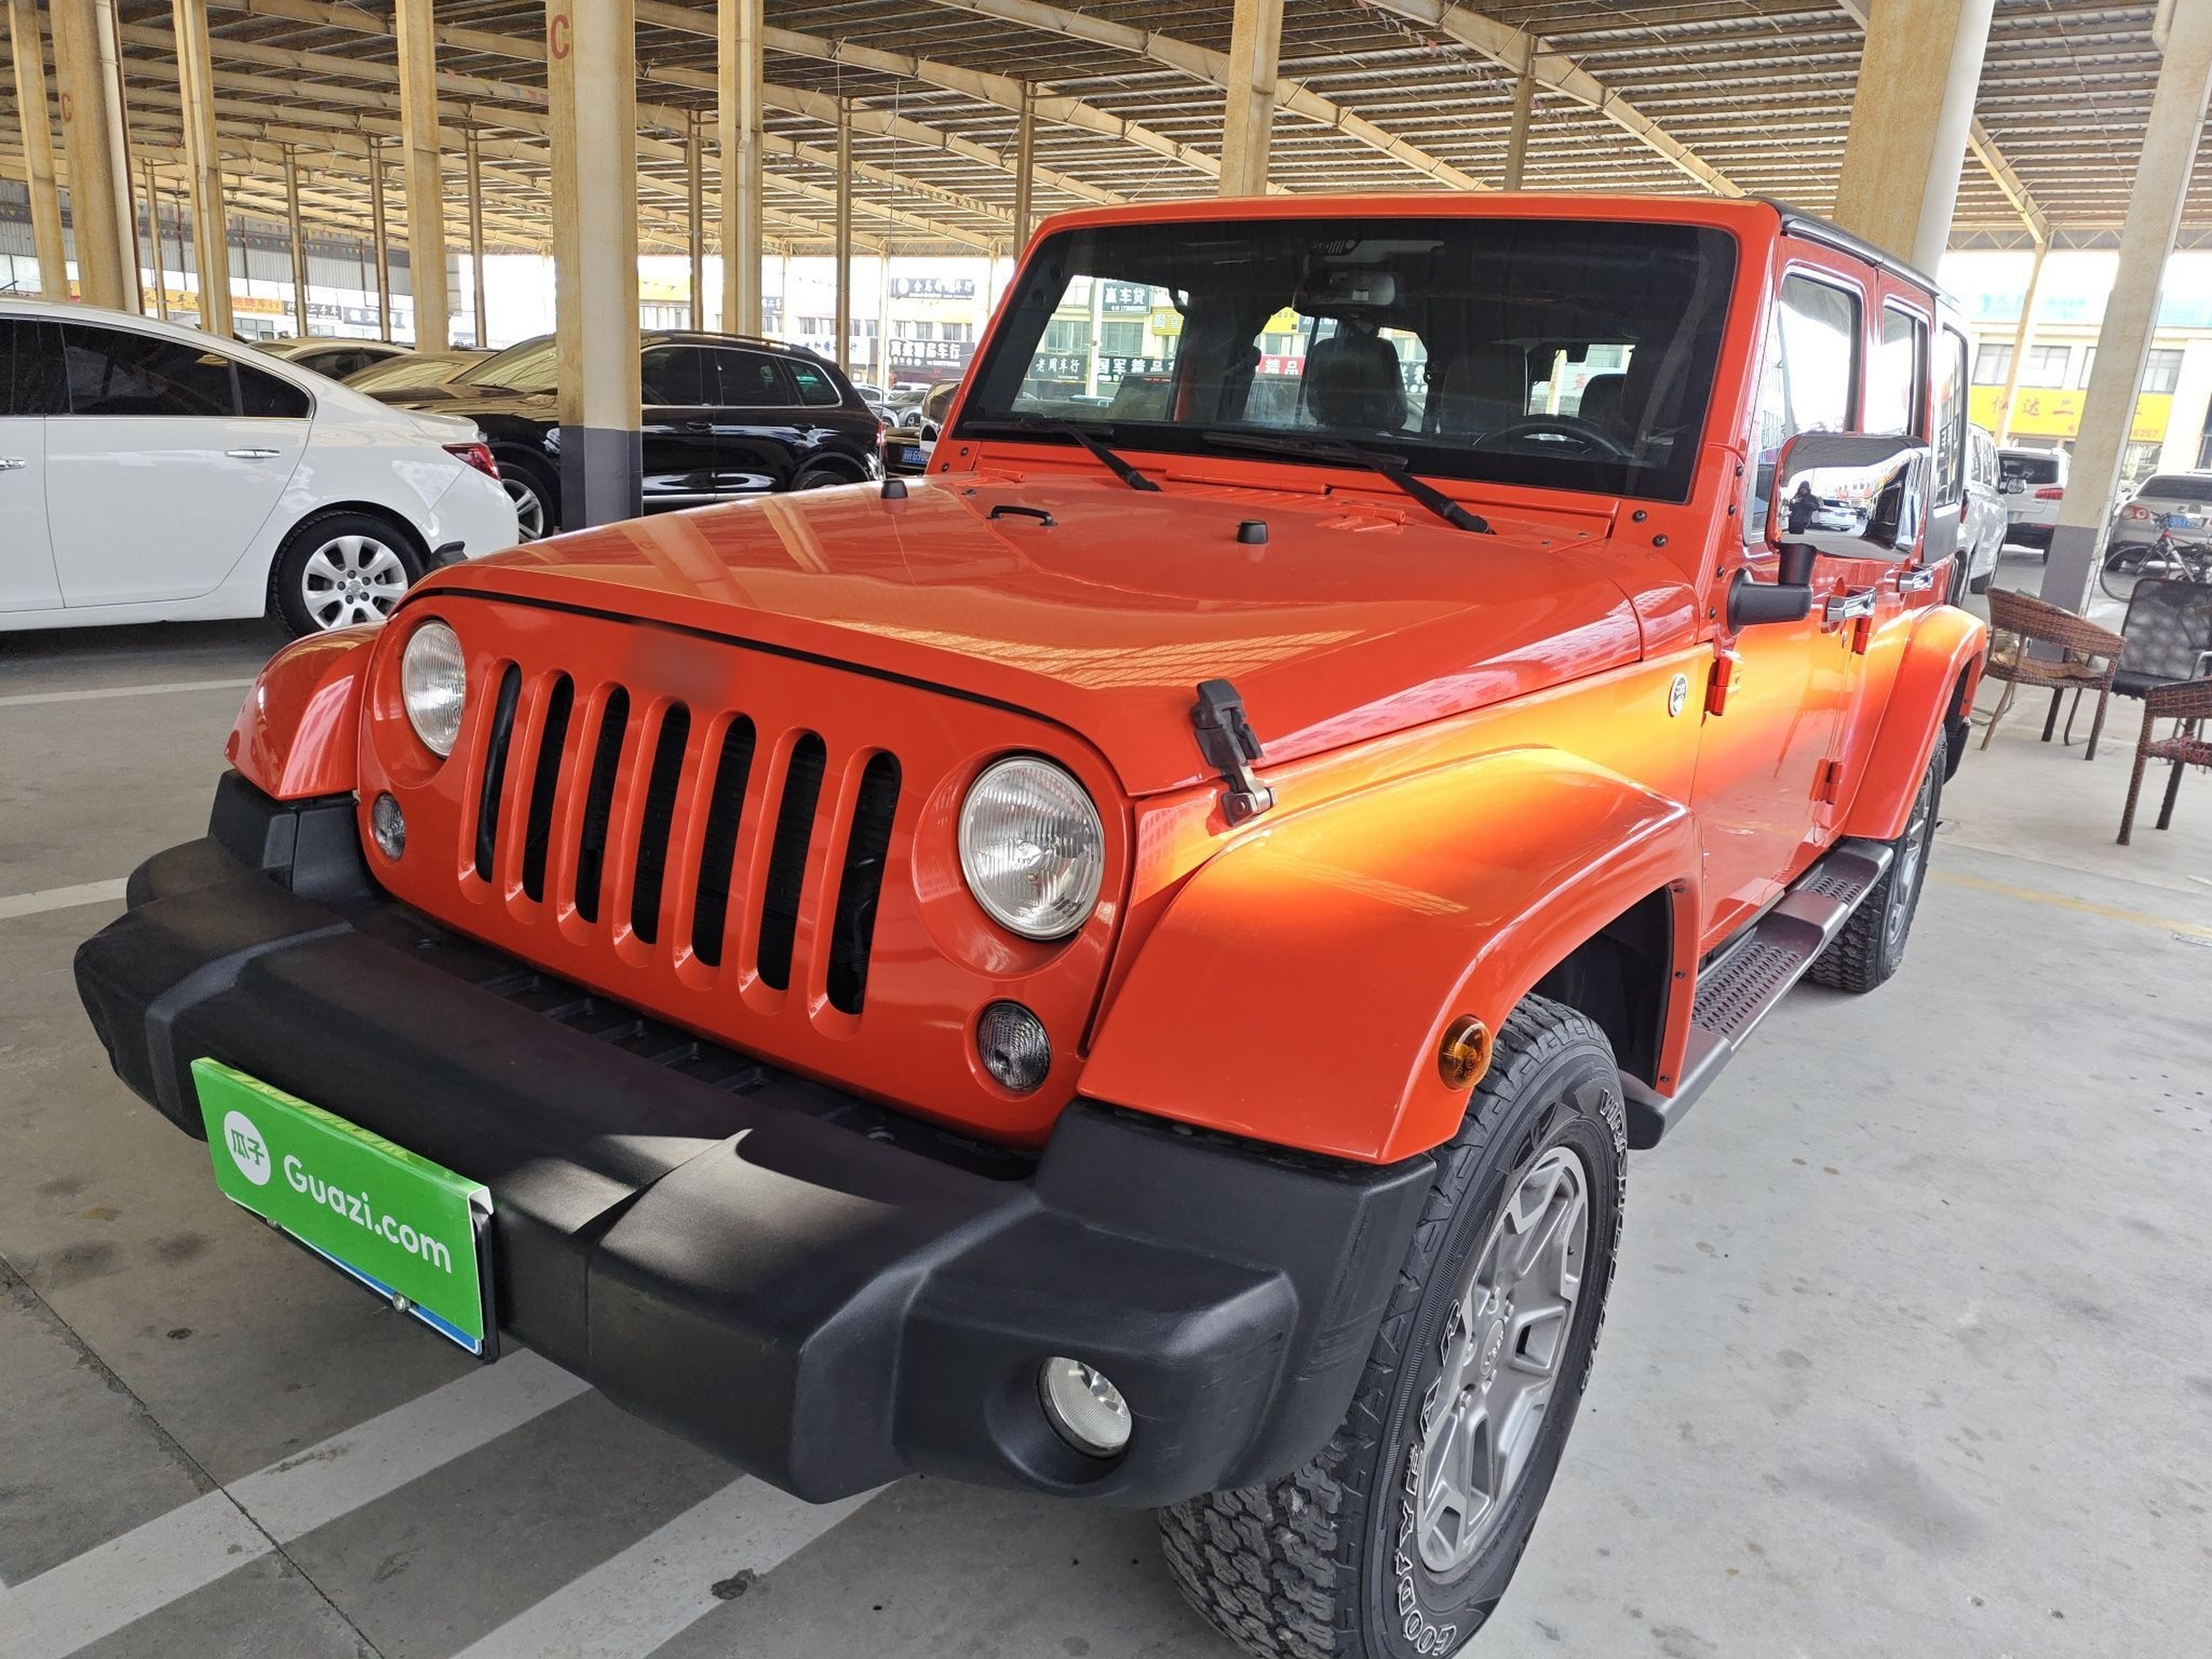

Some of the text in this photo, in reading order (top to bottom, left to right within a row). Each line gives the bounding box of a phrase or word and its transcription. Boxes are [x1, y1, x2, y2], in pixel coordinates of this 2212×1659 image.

[550, 14, 570, 60] C
[61, 93, 72, 123] C
[1036, 358, 1080, 374] 老周车行
[230, 1128, 266, 1166] 瓜子
[283, 1154, 452, 1274] Guazi.com
[1396, 1298, 1460, 1656] GOODYEAR
